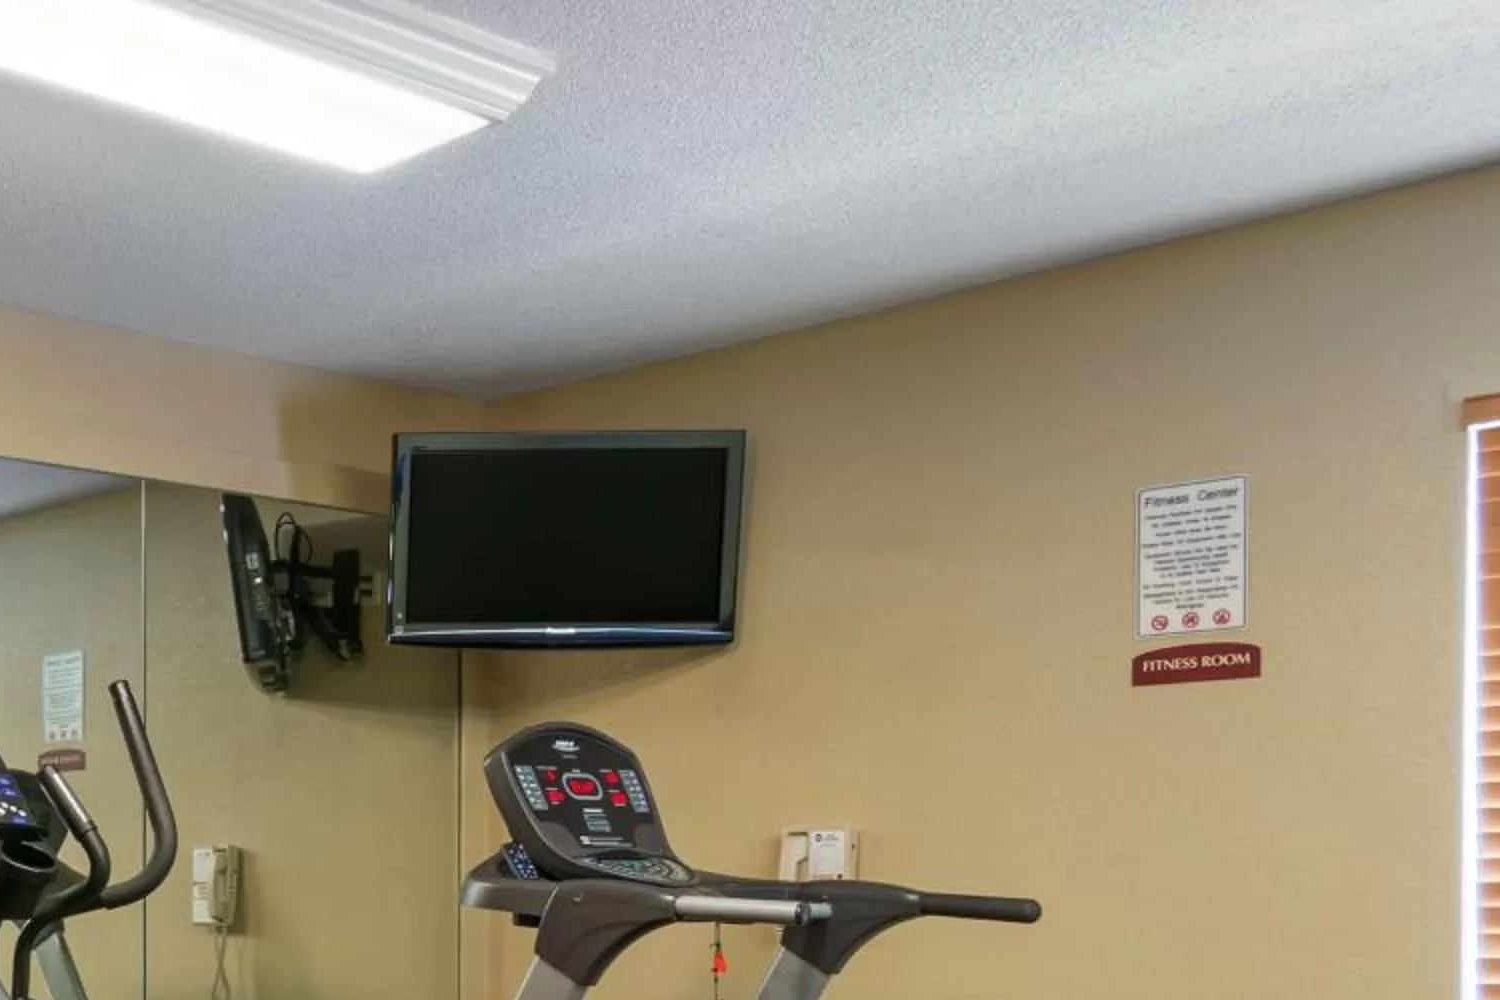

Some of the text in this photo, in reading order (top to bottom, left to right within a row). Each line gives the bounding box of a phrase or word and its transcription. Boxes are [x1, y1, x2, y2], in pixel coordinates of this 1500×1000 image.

[1144, 487, 1239, 508] Fitness Center
[1143, 651, 1251, 672] FITNESS ROOM
